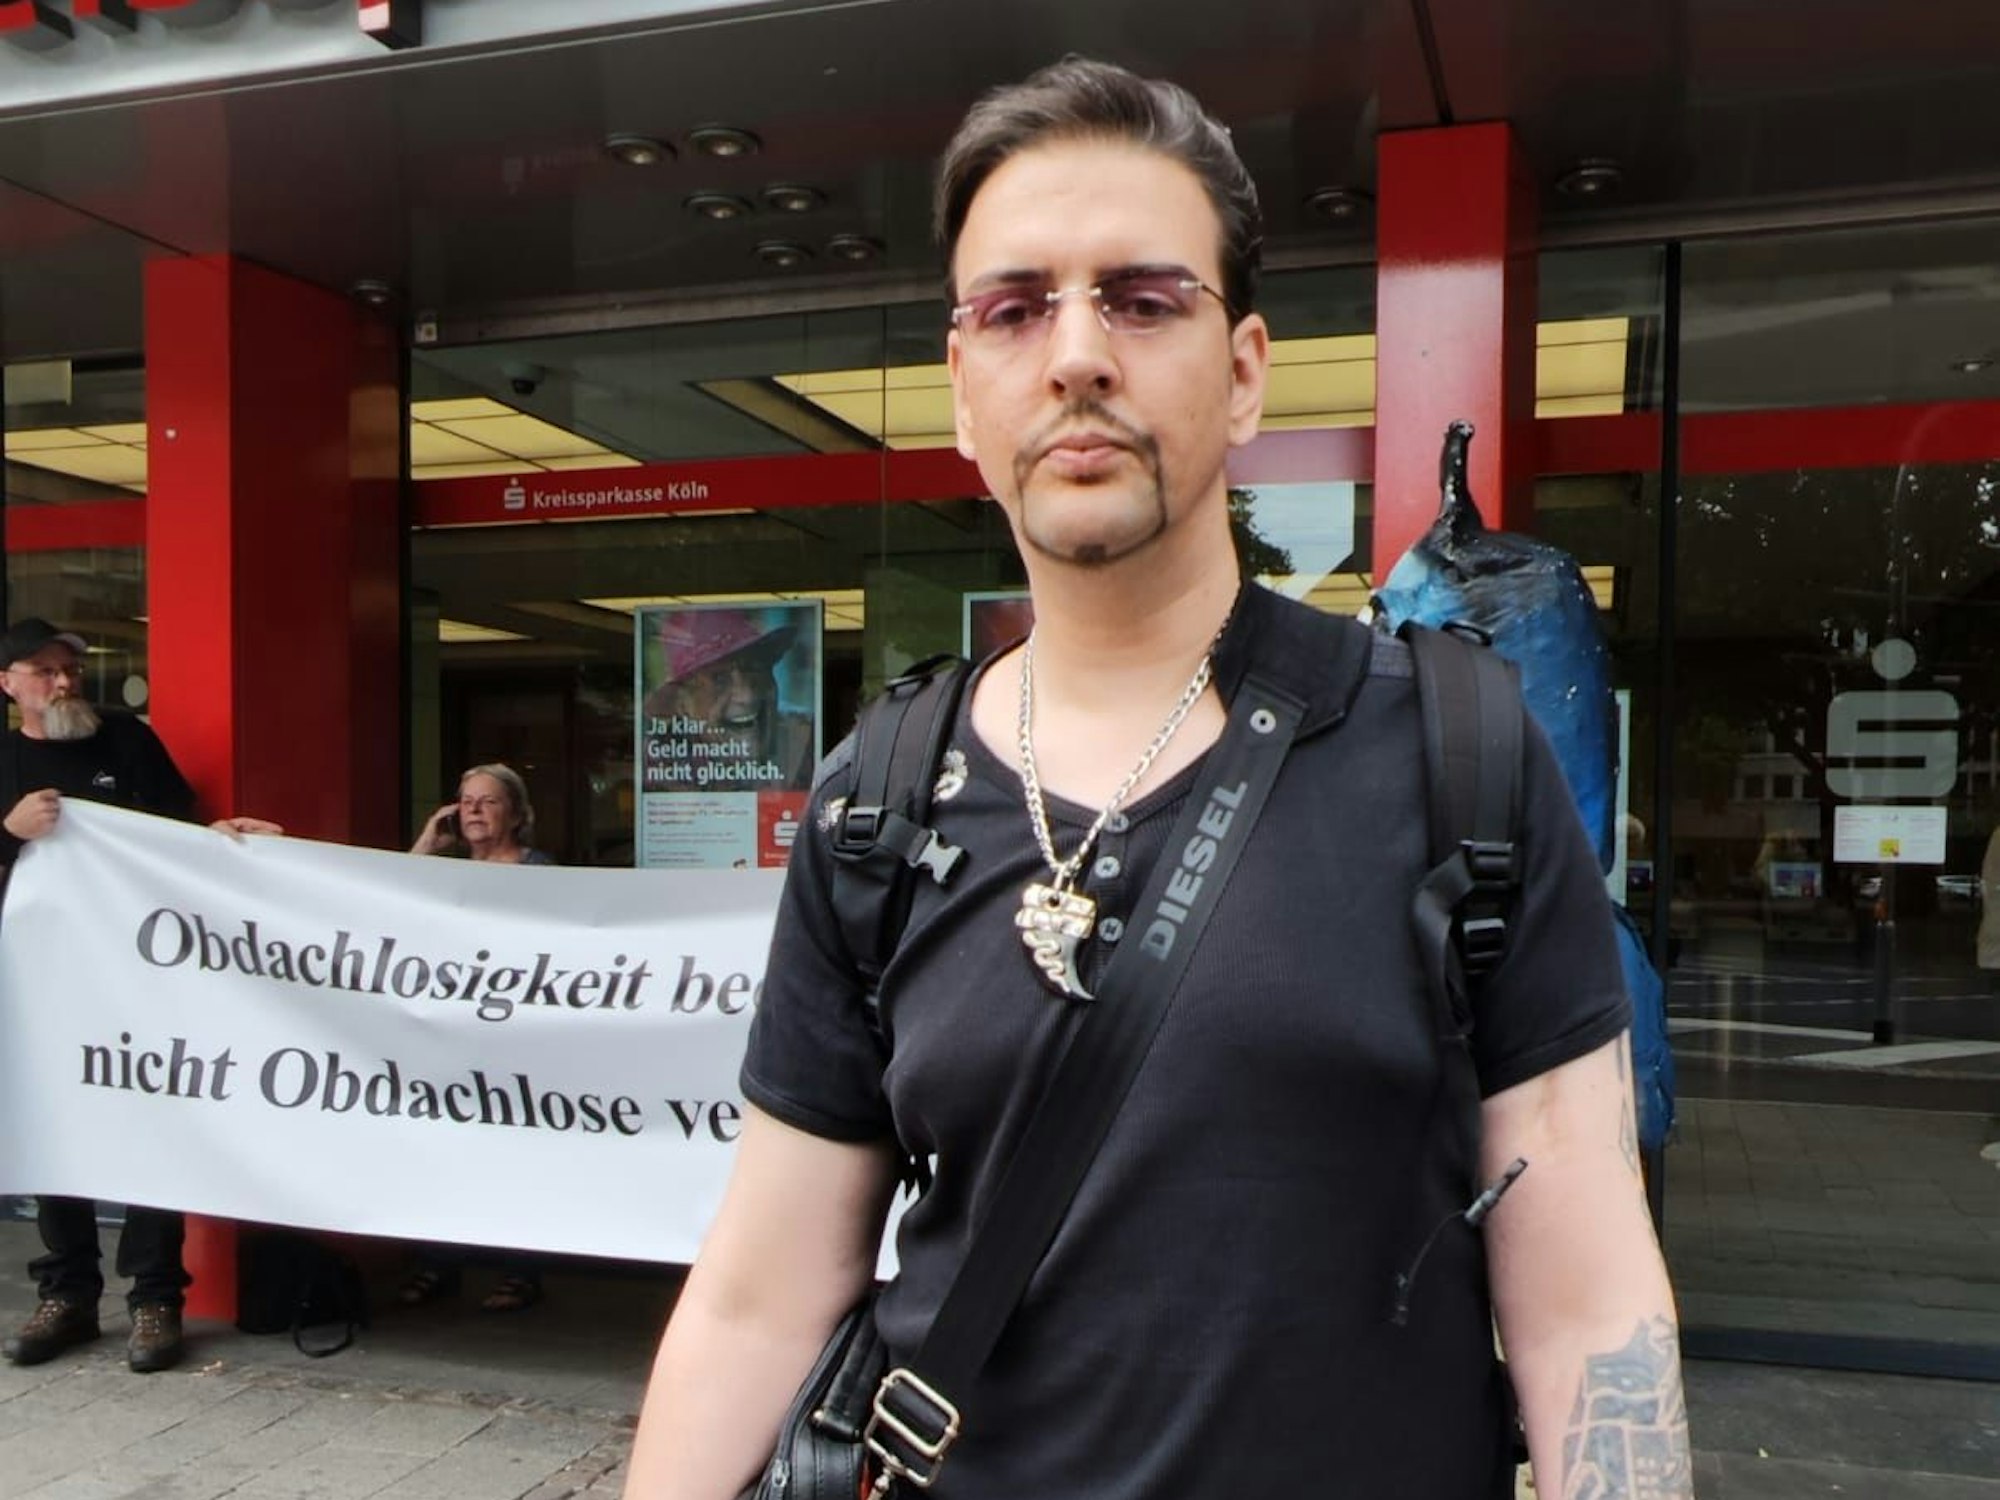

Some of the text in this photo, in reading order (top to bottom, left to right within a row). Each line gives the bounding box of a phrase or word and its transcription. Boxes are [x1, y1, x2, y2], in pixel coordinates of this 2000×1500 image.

[532, 486, 664, 509] Kreissparkasse
[668, 481, 709, 500] Köln
[647, 717, 667, 735] Ja
[648, 738, 750, 757] Geld macht
[648, 760, 784, 785] nicht glücklich.
[1140, 781, 1249, 962] DIESEL
[136, 908, 653, 1021] Obdachlosigkeit
[80, 1032, 741, 1142] nicht Obdachlose ve
